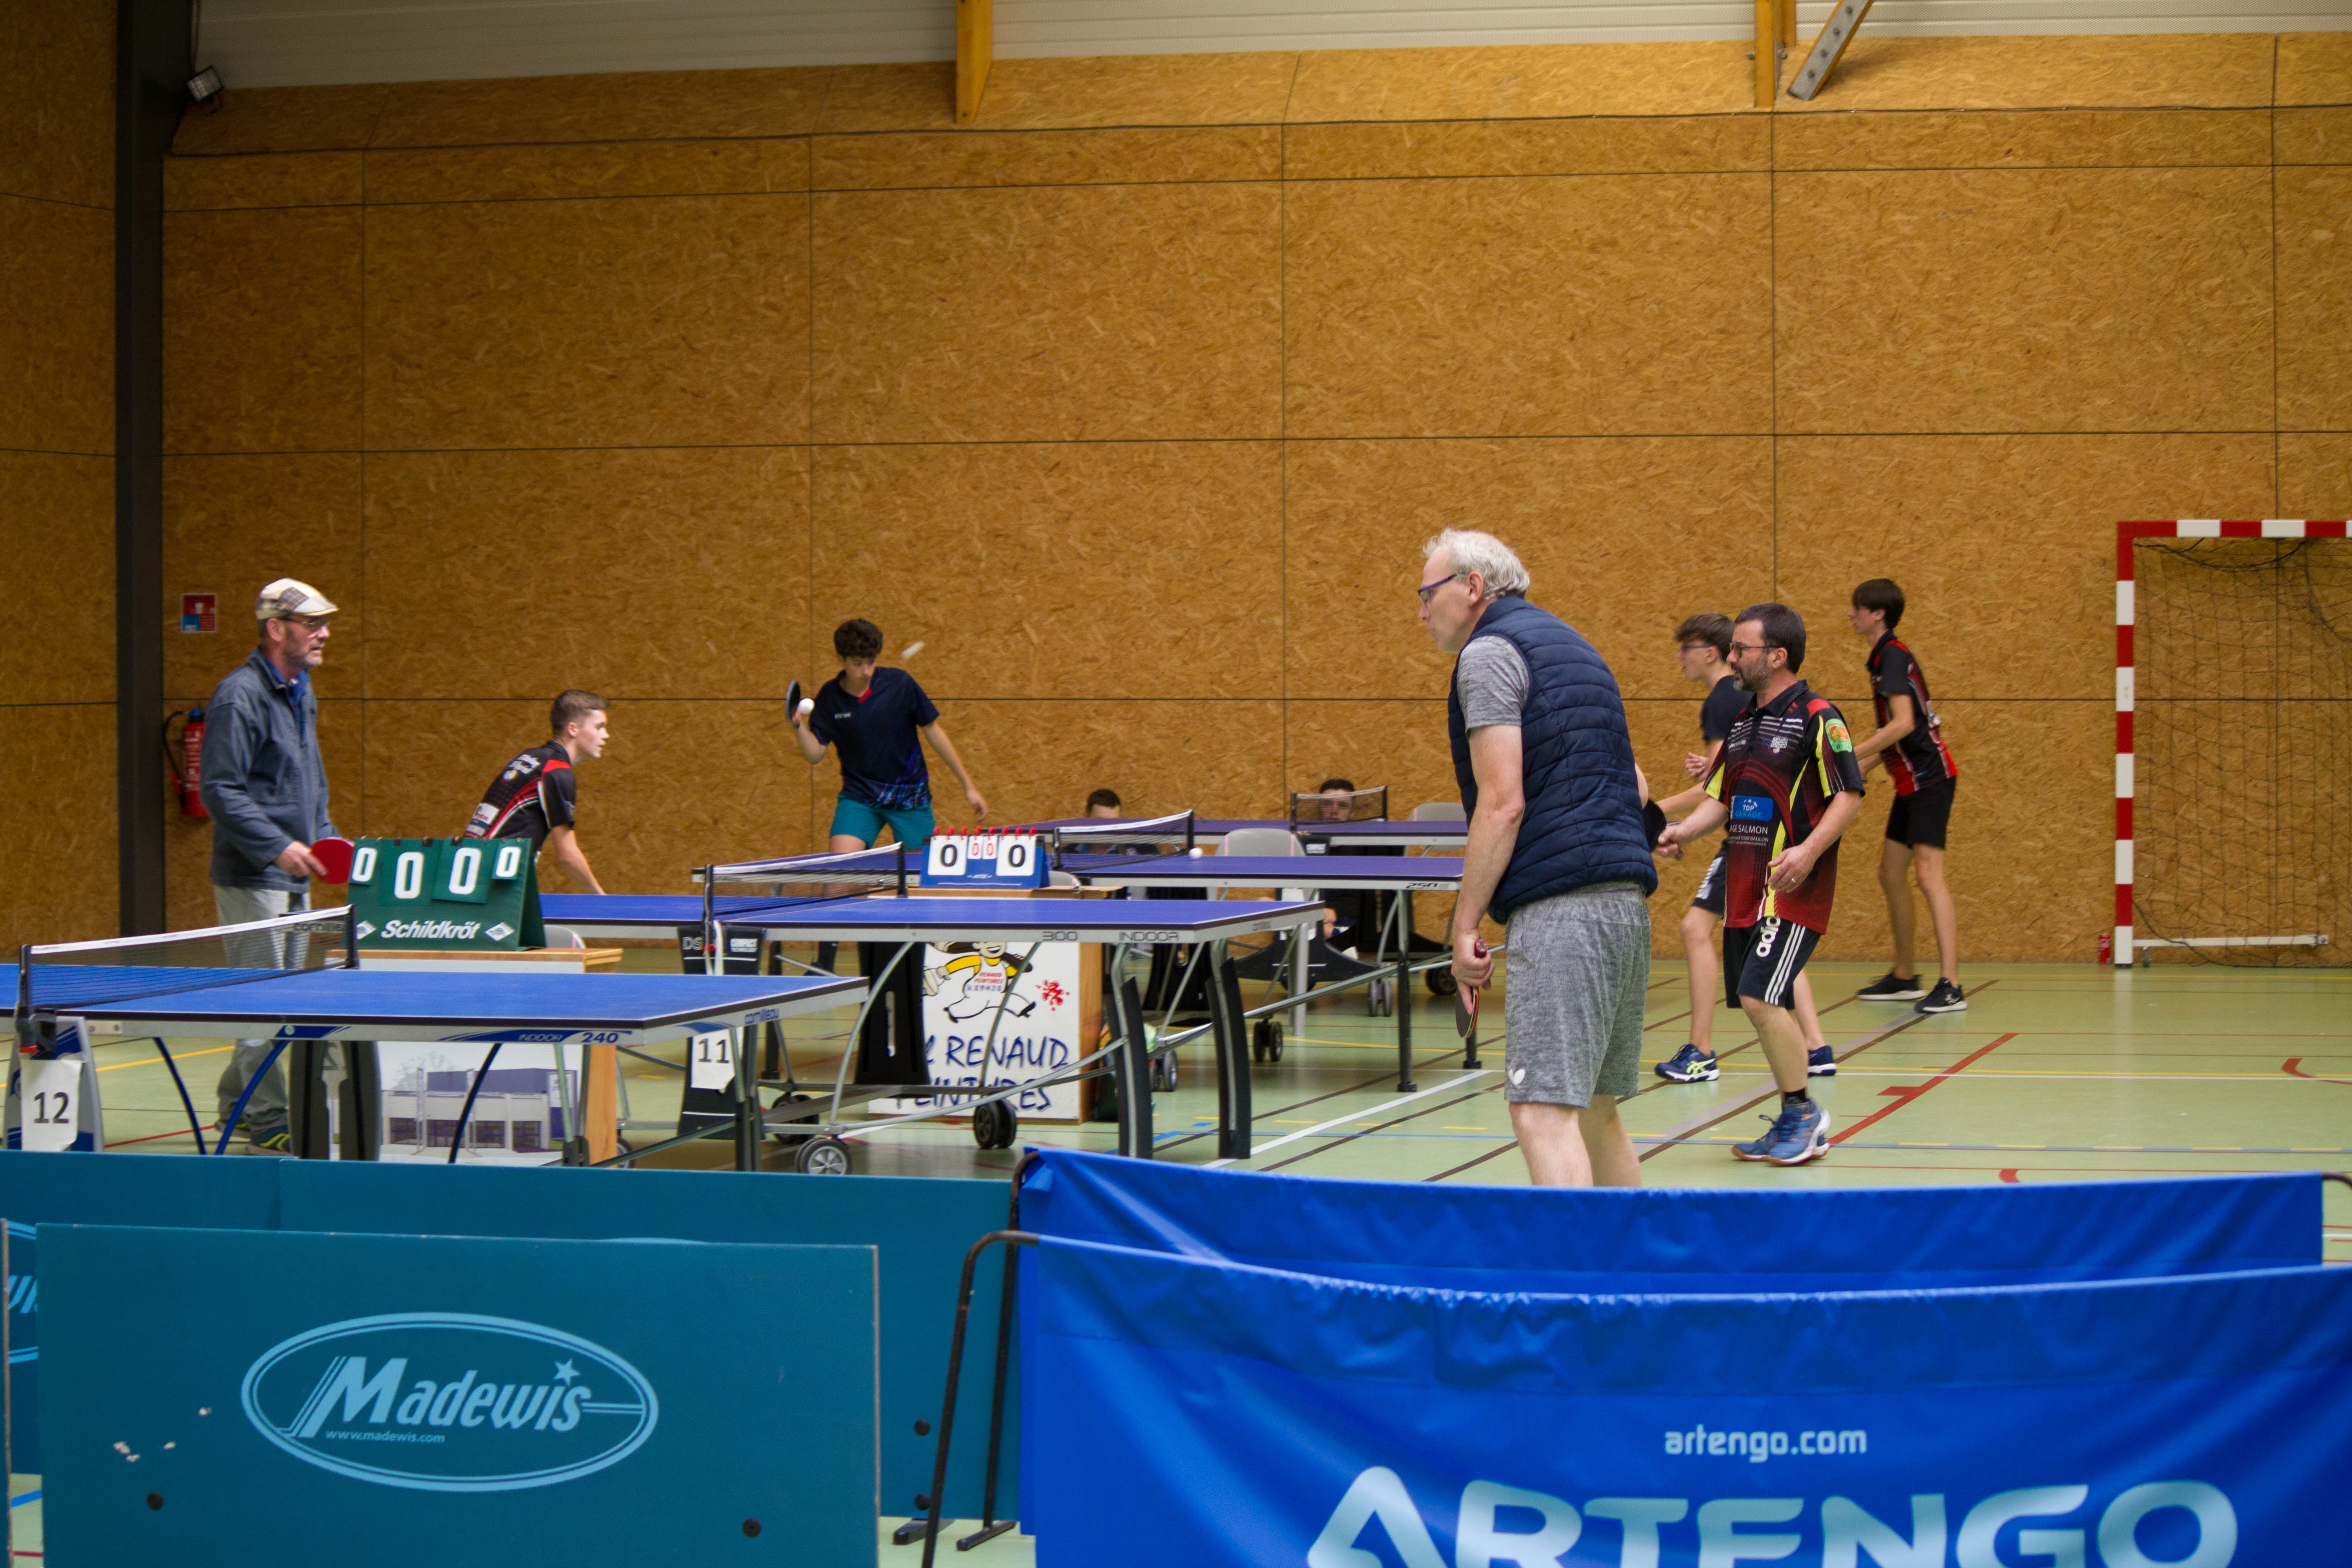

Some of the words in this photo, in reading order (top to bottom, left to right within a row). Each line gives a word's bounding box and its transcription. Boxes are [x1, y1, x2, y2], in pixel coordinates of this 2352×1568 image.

[1738, 824, 1768, 834] SALMON
[941, 844, 957, 867] 0
[972, 843, 979, 856] 0
[986, 843, 994, 856] 0
[1009, 844, 1025, 867] 0
[352, 848, 377, 882] 0
[394, 852, 424, 899] 0
[448, 847, 482, 894] 0
[496, 847, 521, 877] 0
[381, 920, 481, 939] Schildkröt
[1042, 931, 1078, 941] 300
[1119, 931, 1179, 941] INDOOR
[581, 1032, 619, 1044] 240
[698, 1038, 730, 1063] 11
[946, 1035, 1068, 1069] RENAUD
[34, 1092, 69, 1124] 12
[298, 1356, 592, 1438] Madewis
[325, 1430, 445, 1444] www.madewis.com
[1665, 1424, 1867, 1463] artengo.com
[1308, 1465, 2238, 1568] ARTENGO
